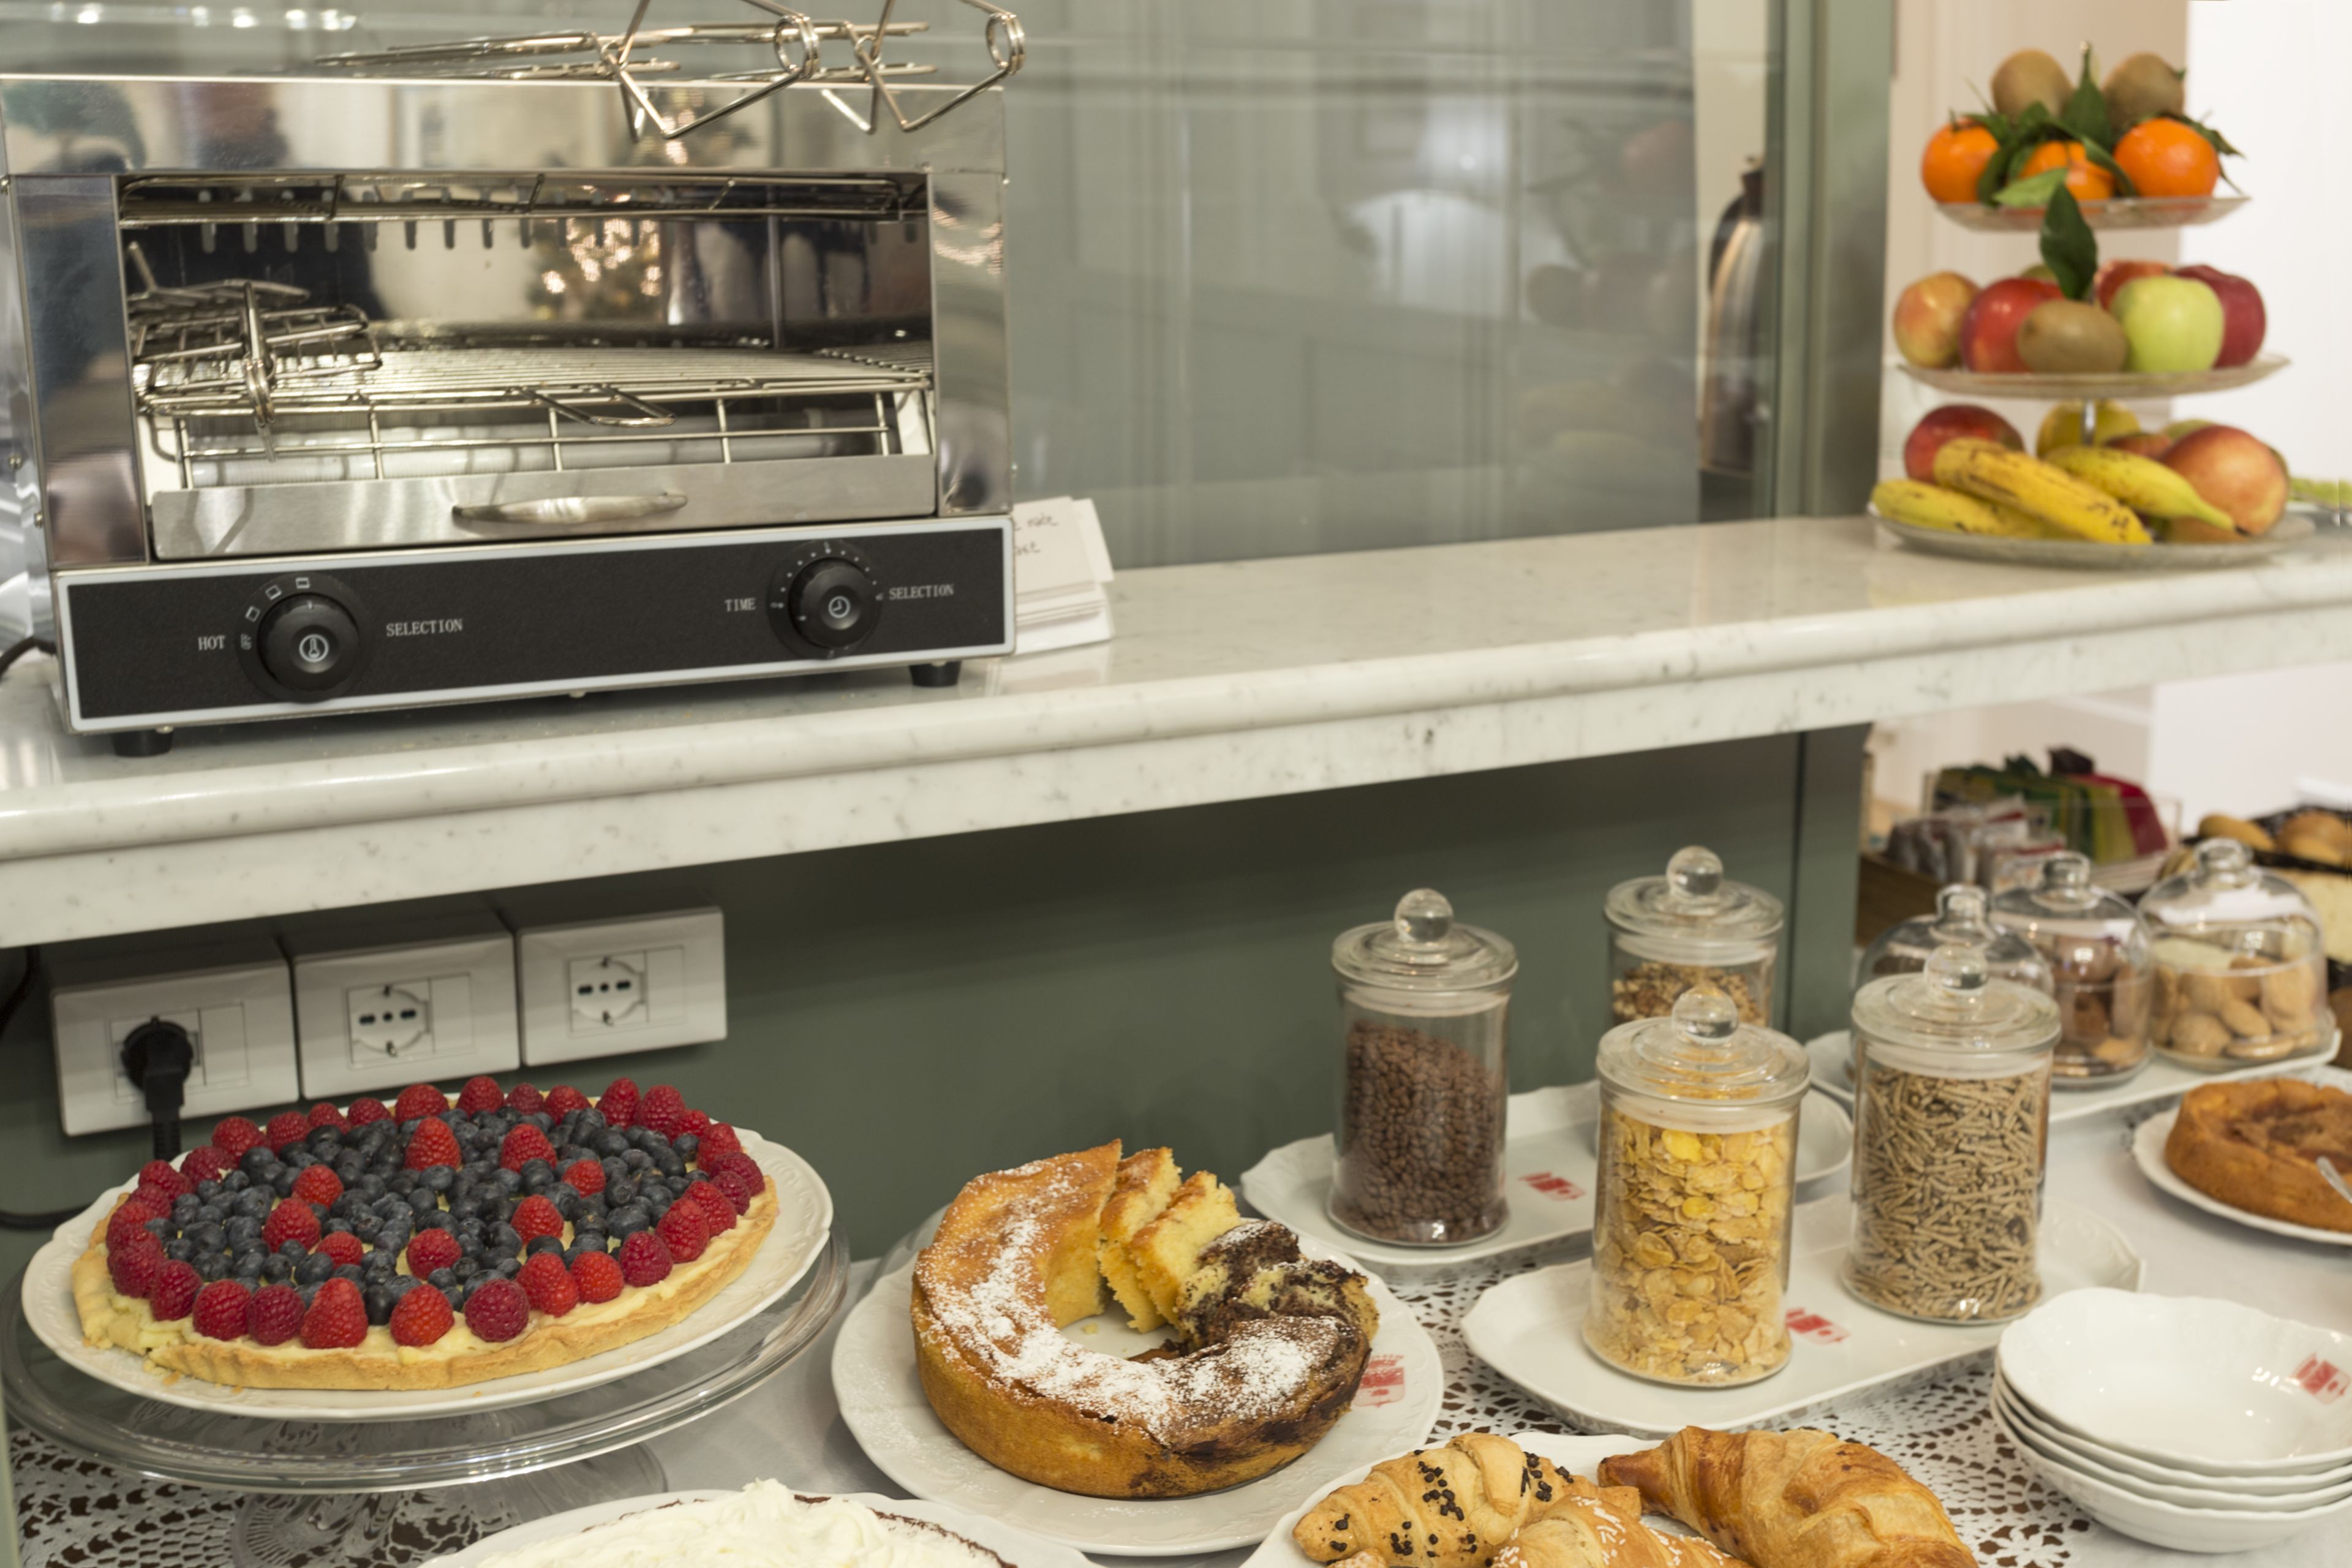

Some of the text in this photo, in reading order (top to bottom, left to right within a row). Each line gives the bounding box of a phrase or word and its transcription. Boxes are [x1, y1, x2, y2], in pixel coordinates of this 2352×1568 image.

[889, 584, 955, 600] SELECTION
[725, 597, 756, 612] TIME
[386, 619, 463, 637] SELECTION
[198, 635, 225, 650] HOT
